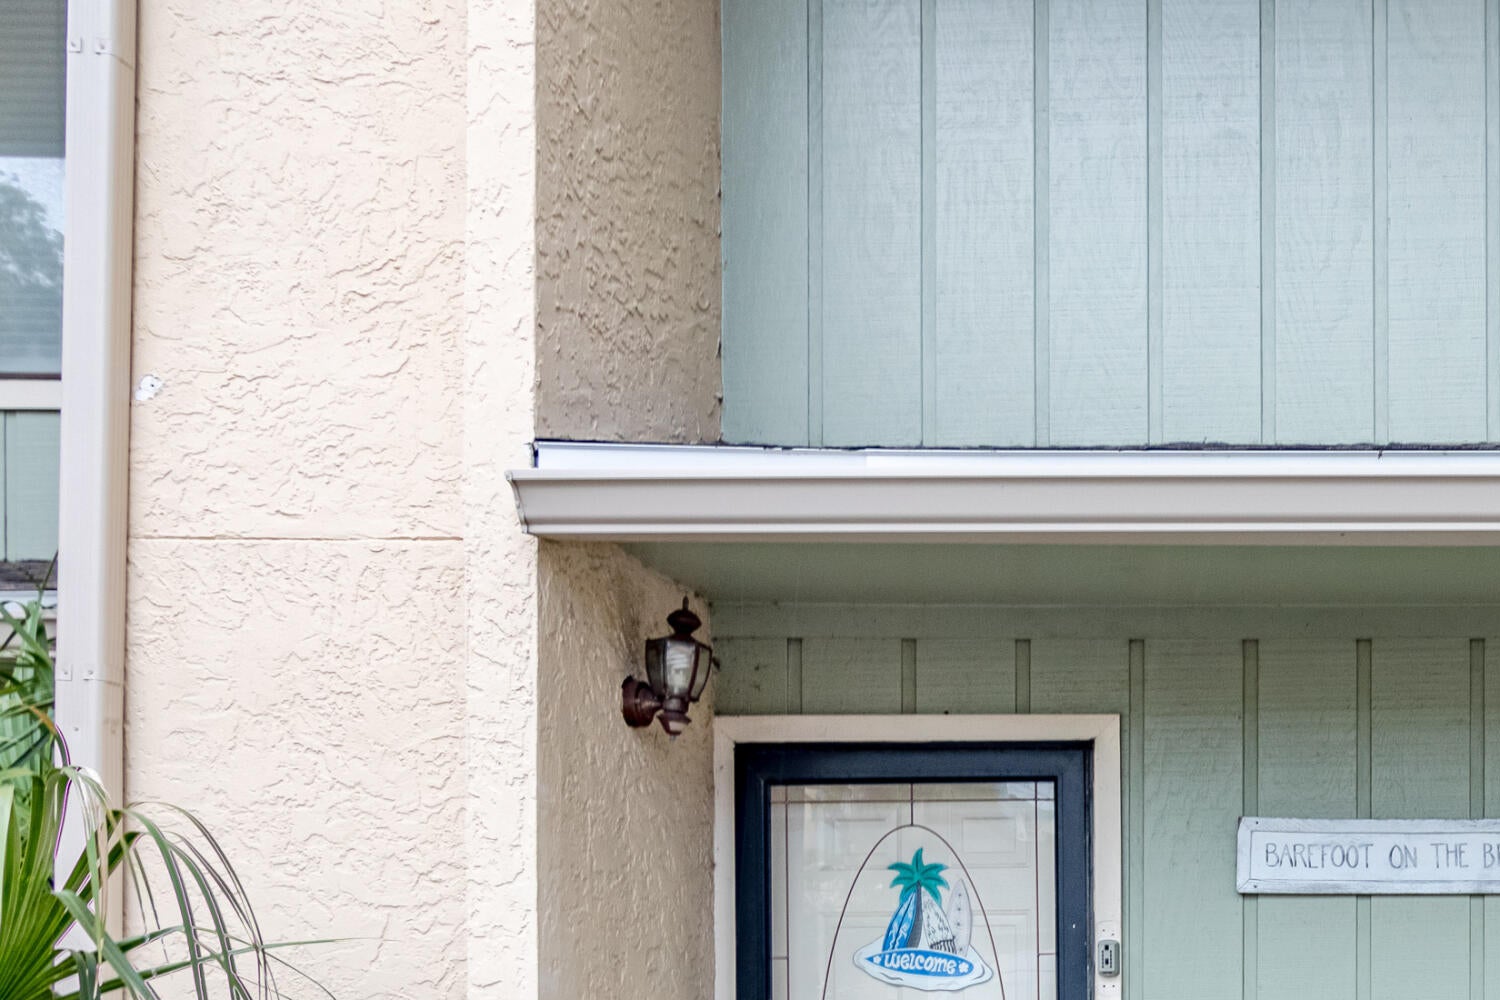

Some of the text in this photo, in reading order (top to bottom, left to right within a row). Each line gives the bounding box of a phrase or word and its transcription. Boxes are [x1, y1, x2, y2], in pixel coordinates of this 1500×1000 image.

[1264, 842, 1374, 869] BAREFOOT
[1389, 843, 1418, 869] ON
[1430, 842, 1469, 869] THE
[884, 953, 957, 974] welcome
